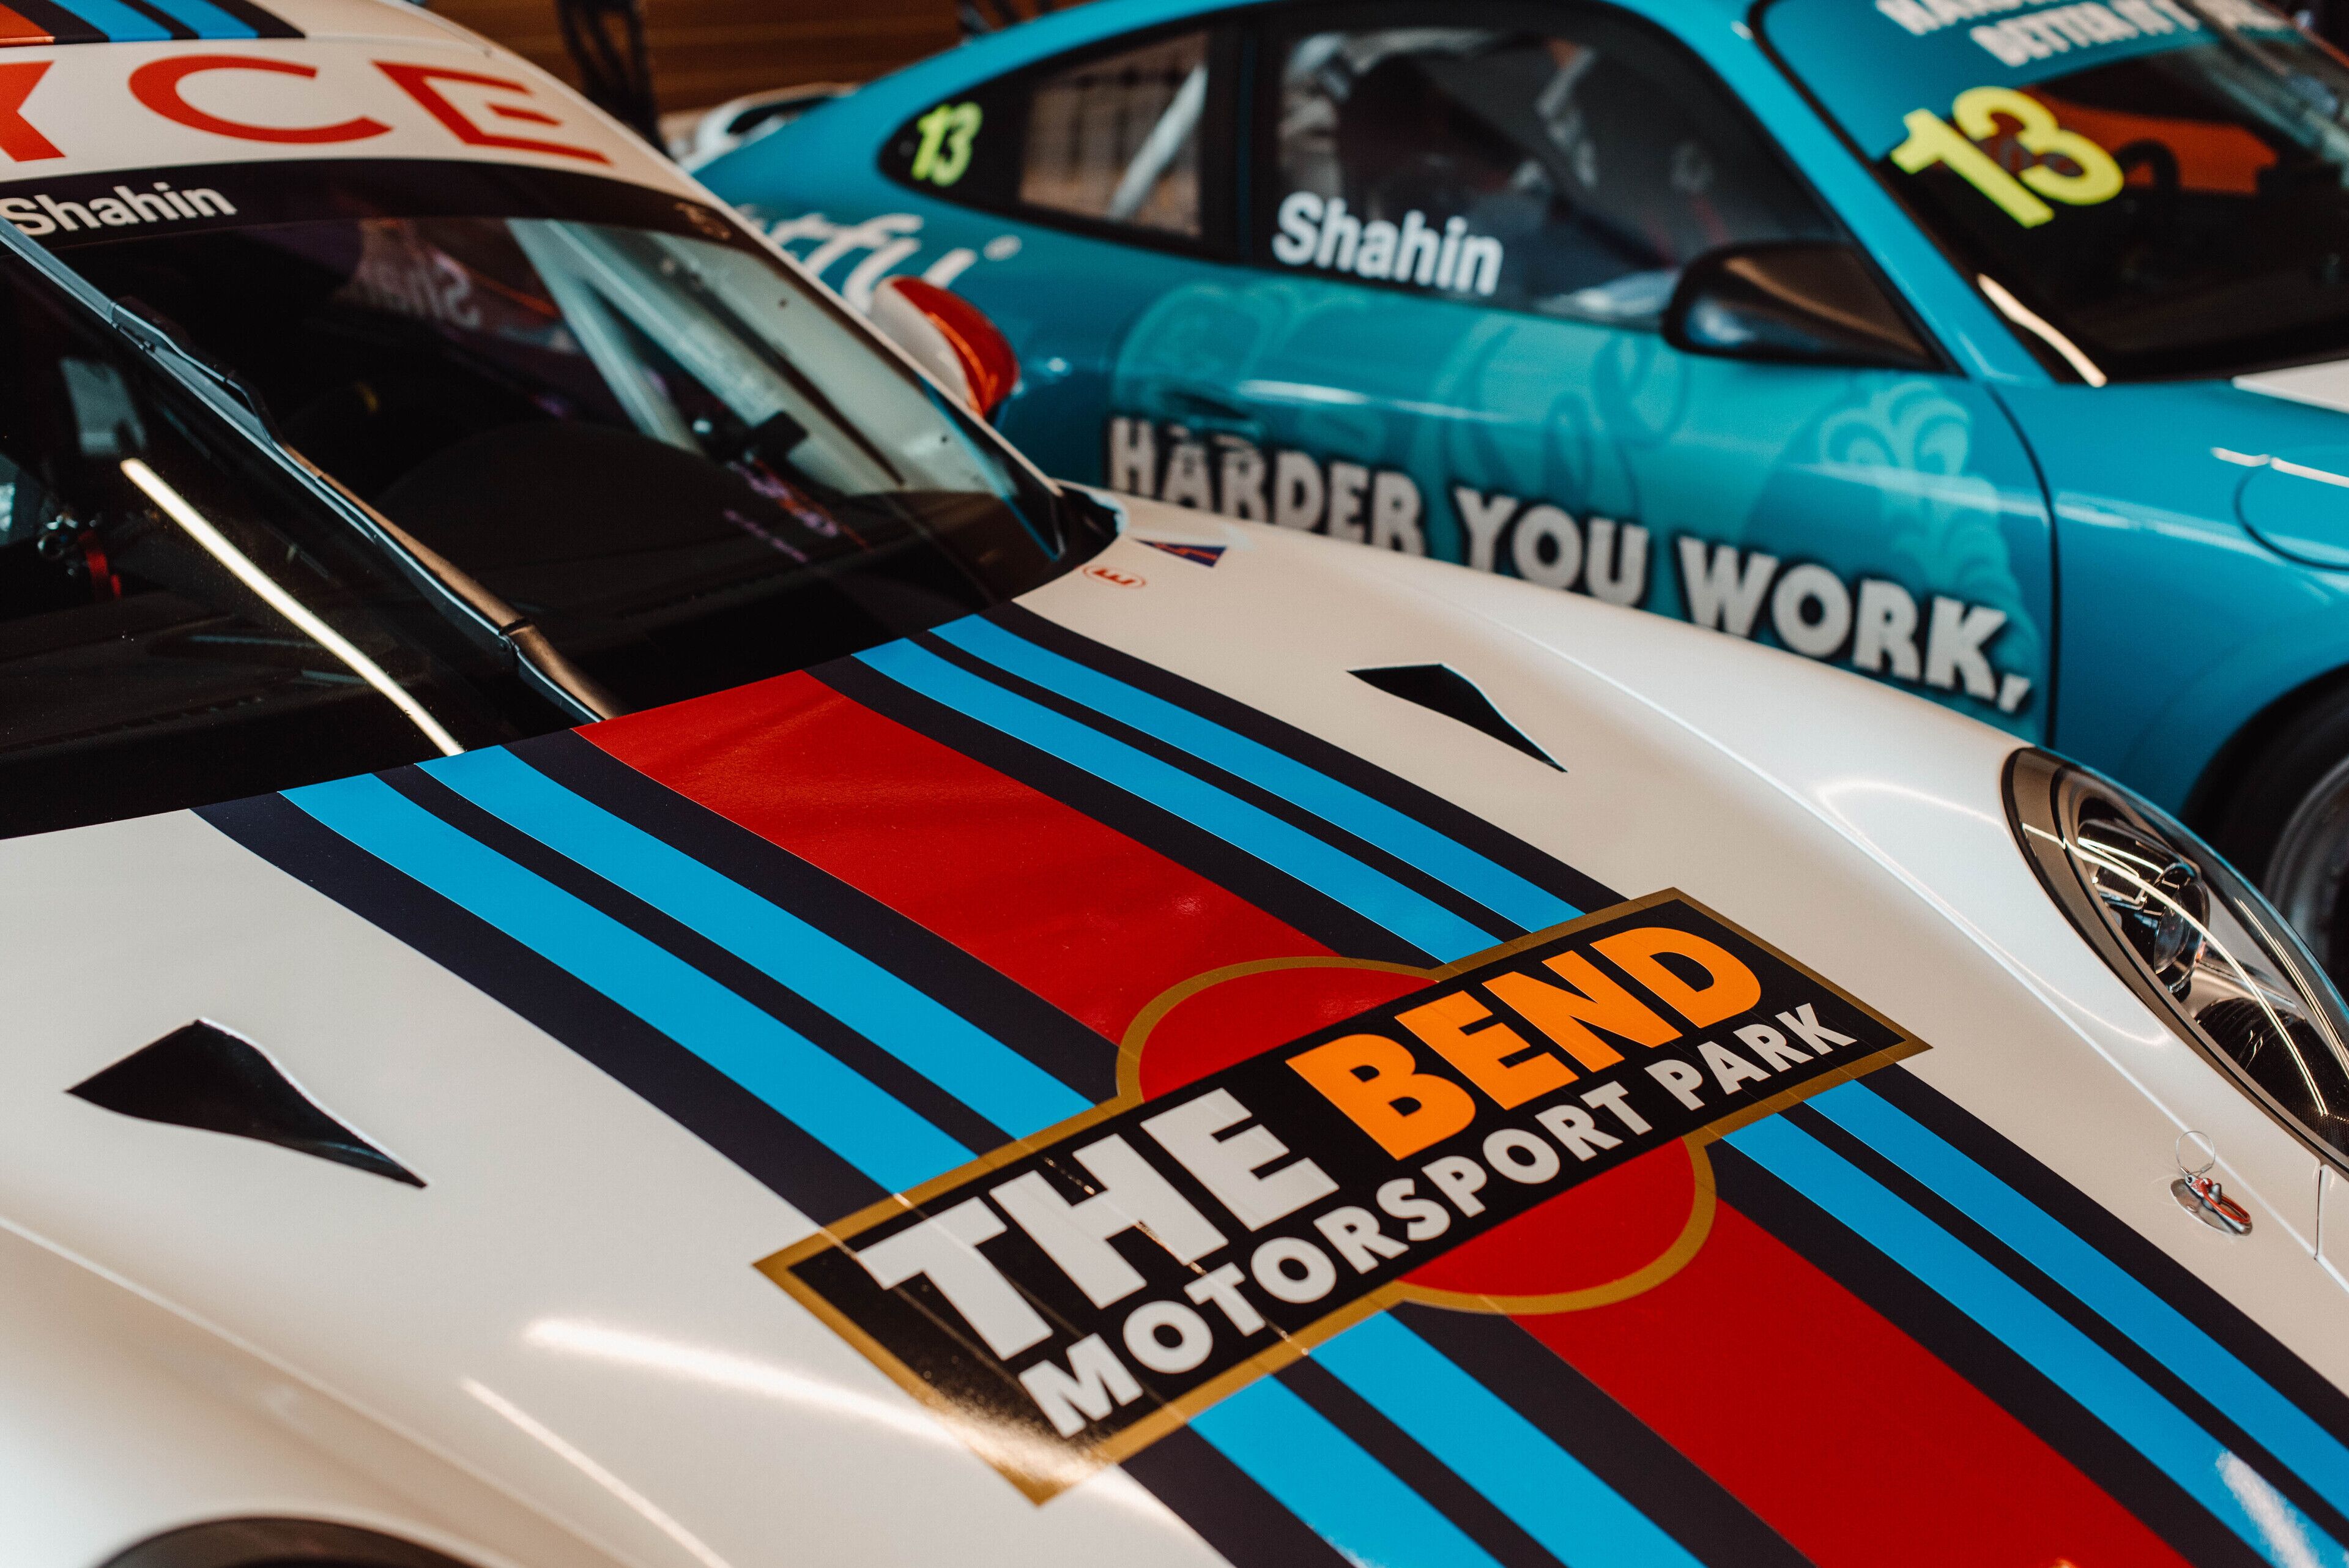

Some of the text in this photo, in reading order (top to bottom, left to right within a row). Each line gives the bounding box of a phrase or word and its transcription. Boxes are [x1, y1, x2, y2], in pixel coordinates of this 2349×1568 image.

[0, 182, 237, 236] Shahin
[912, 102, 983, 187] 13
[1890, 85, 2124, 229] 13
[1271, 191, 1504, 297] Shahin
[1110, 417, 2032, 714] HARDER YOU WORK,
[856, 927, 1762, 1361] THE BEND
[1018, 1003, 1858, 1440] MOTORSPORT PARK
